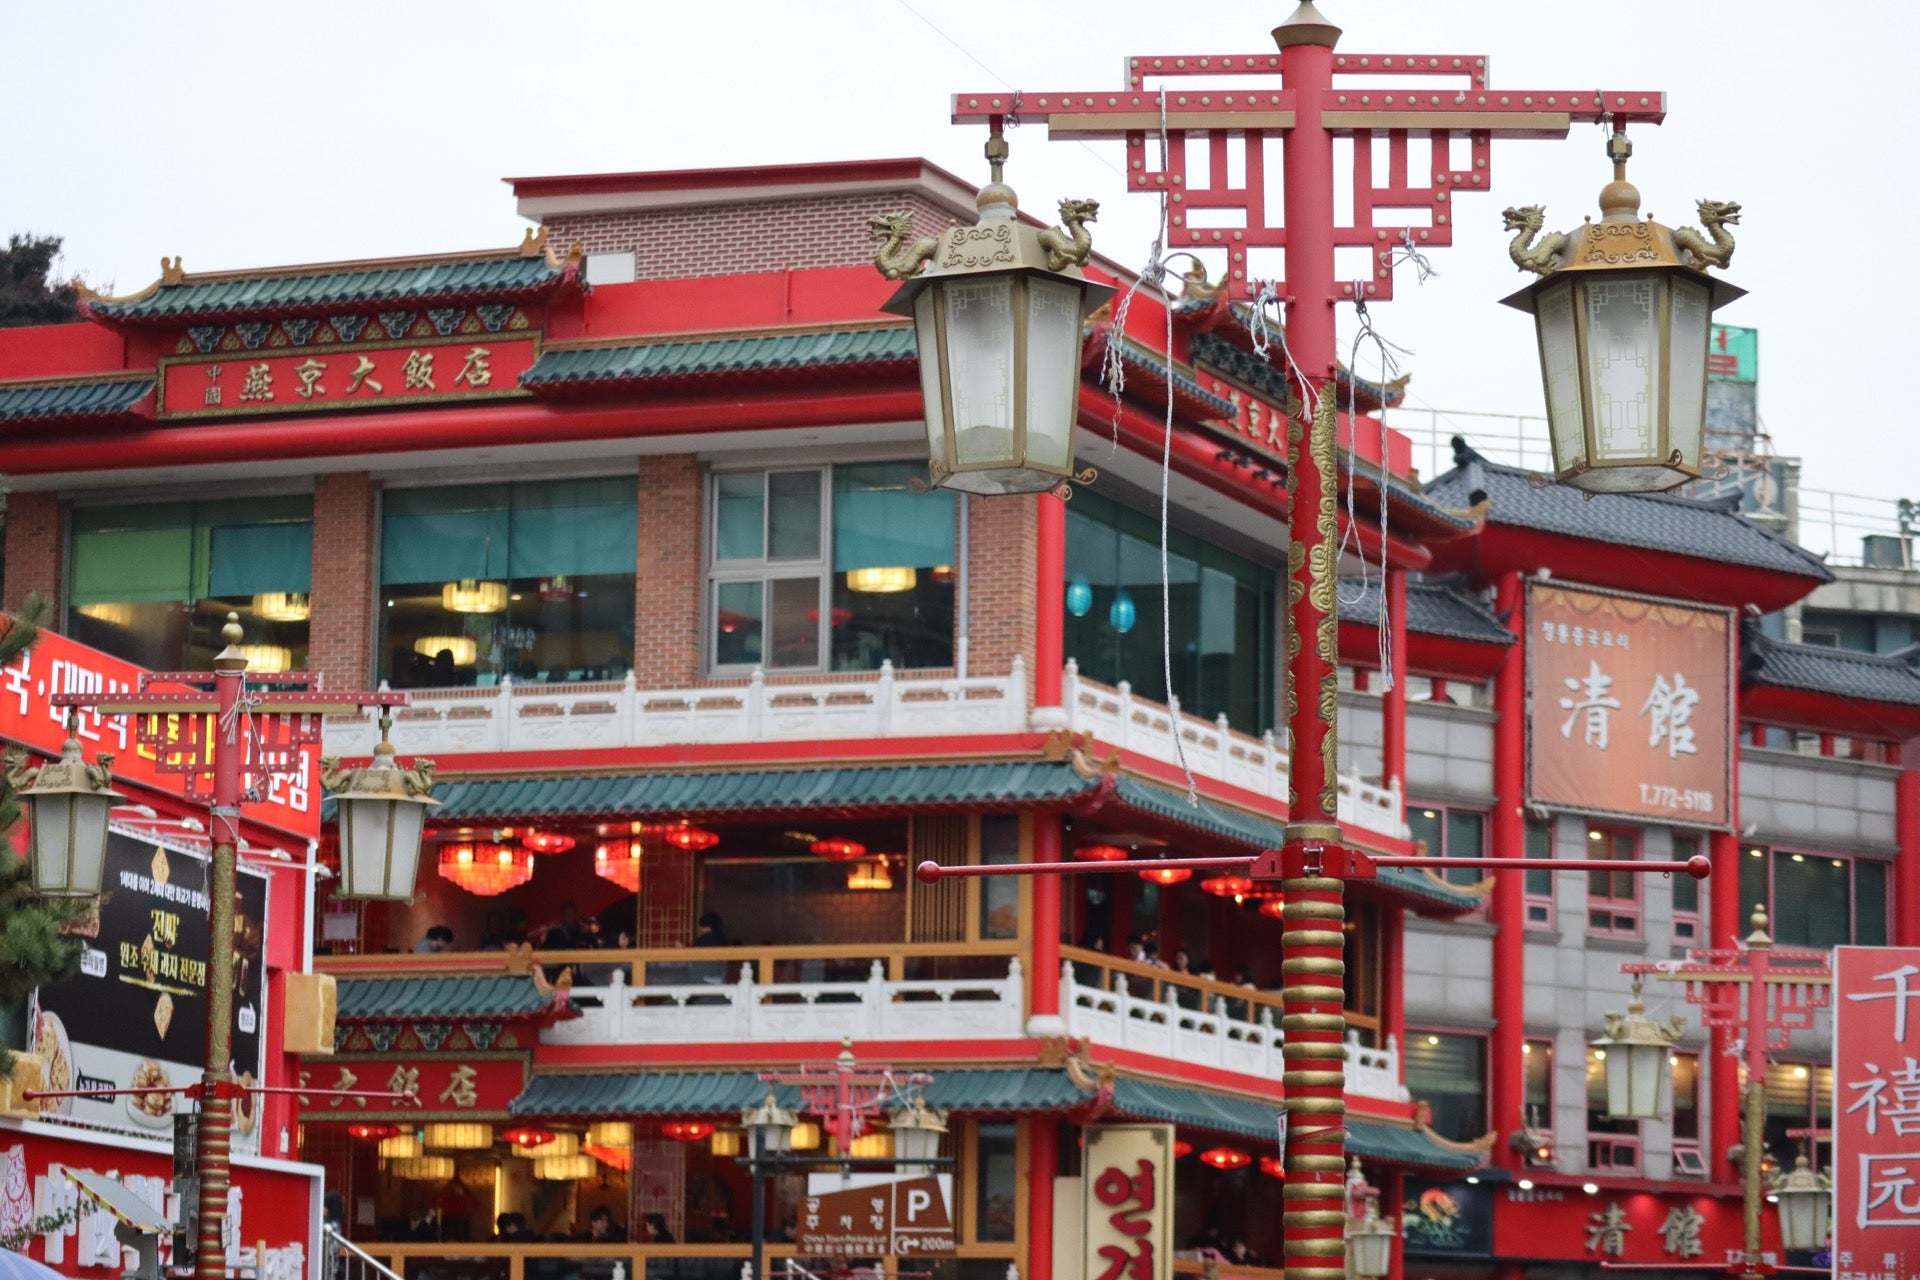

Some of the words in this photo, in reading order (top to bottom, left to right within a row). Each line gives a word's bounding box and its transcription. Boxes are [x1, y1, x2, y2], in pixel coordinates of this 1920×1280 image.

[239, 347, 493, 402] 燕京大飯店
[1559, 659, 1700, 760] 清館
[907, 1189, 931, 1222] P
[921, 1237, 955, 1251] 200m
